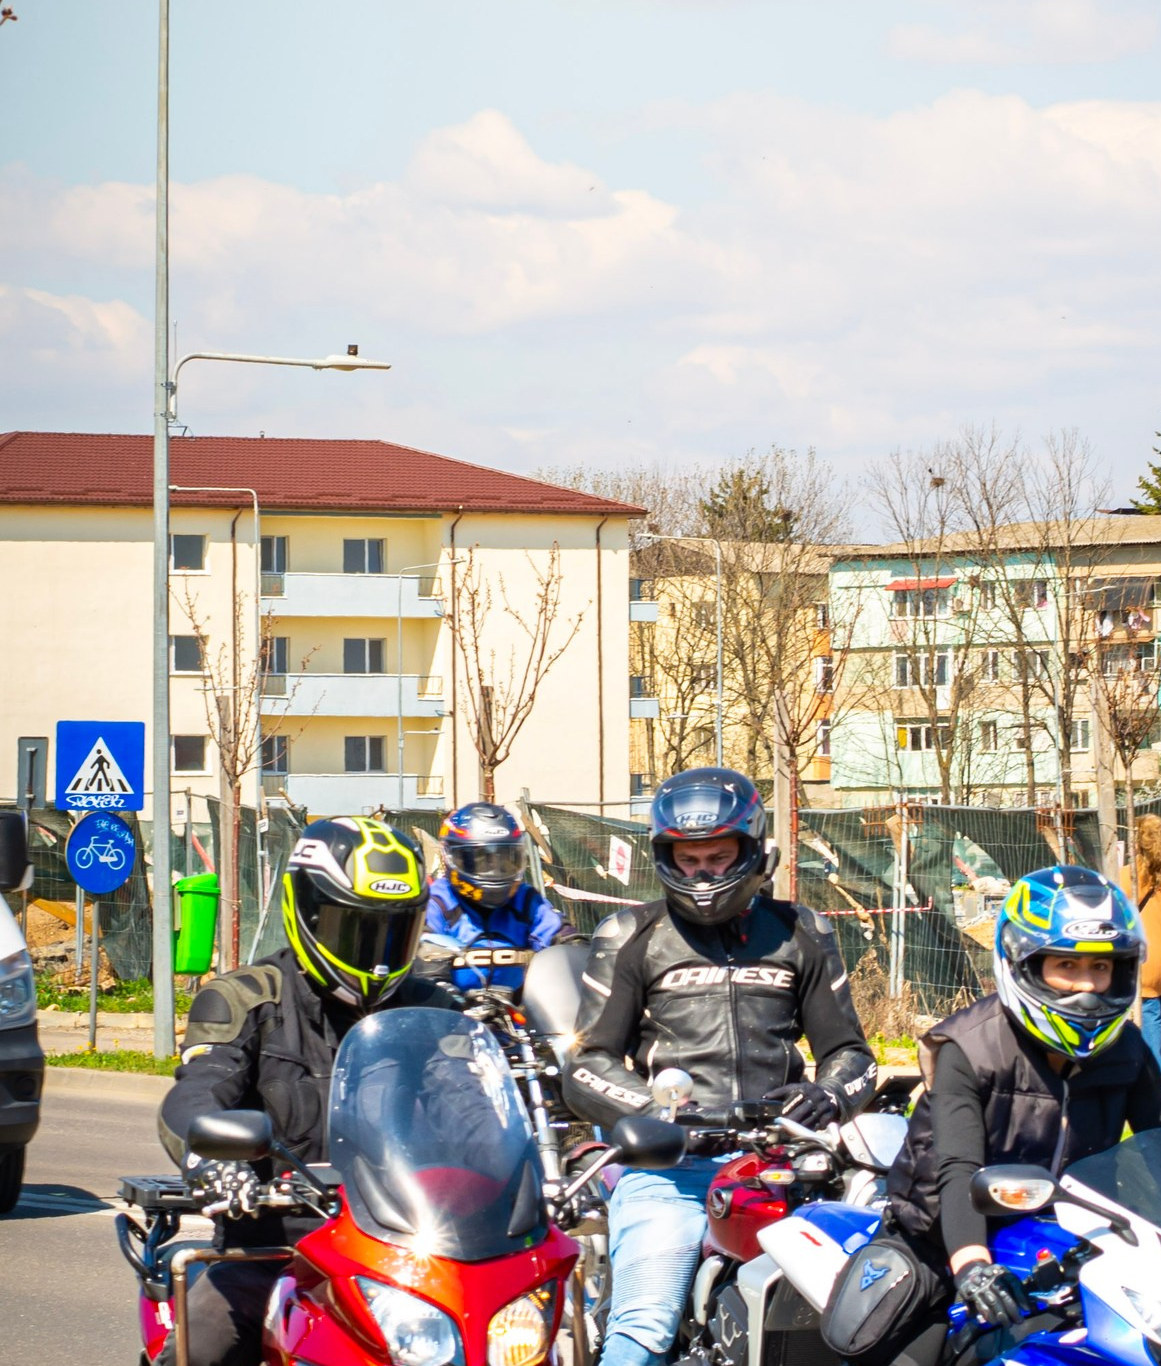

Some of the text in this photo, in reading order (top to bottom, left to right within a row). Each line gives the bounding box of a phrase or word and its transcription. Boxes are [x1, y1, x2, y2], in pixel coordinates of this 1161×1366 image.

[374, 882, 407, 892] HJC
[661, 966, 795, 988] DAINESE
[572, 1067, 651, 1108] DAINESE
